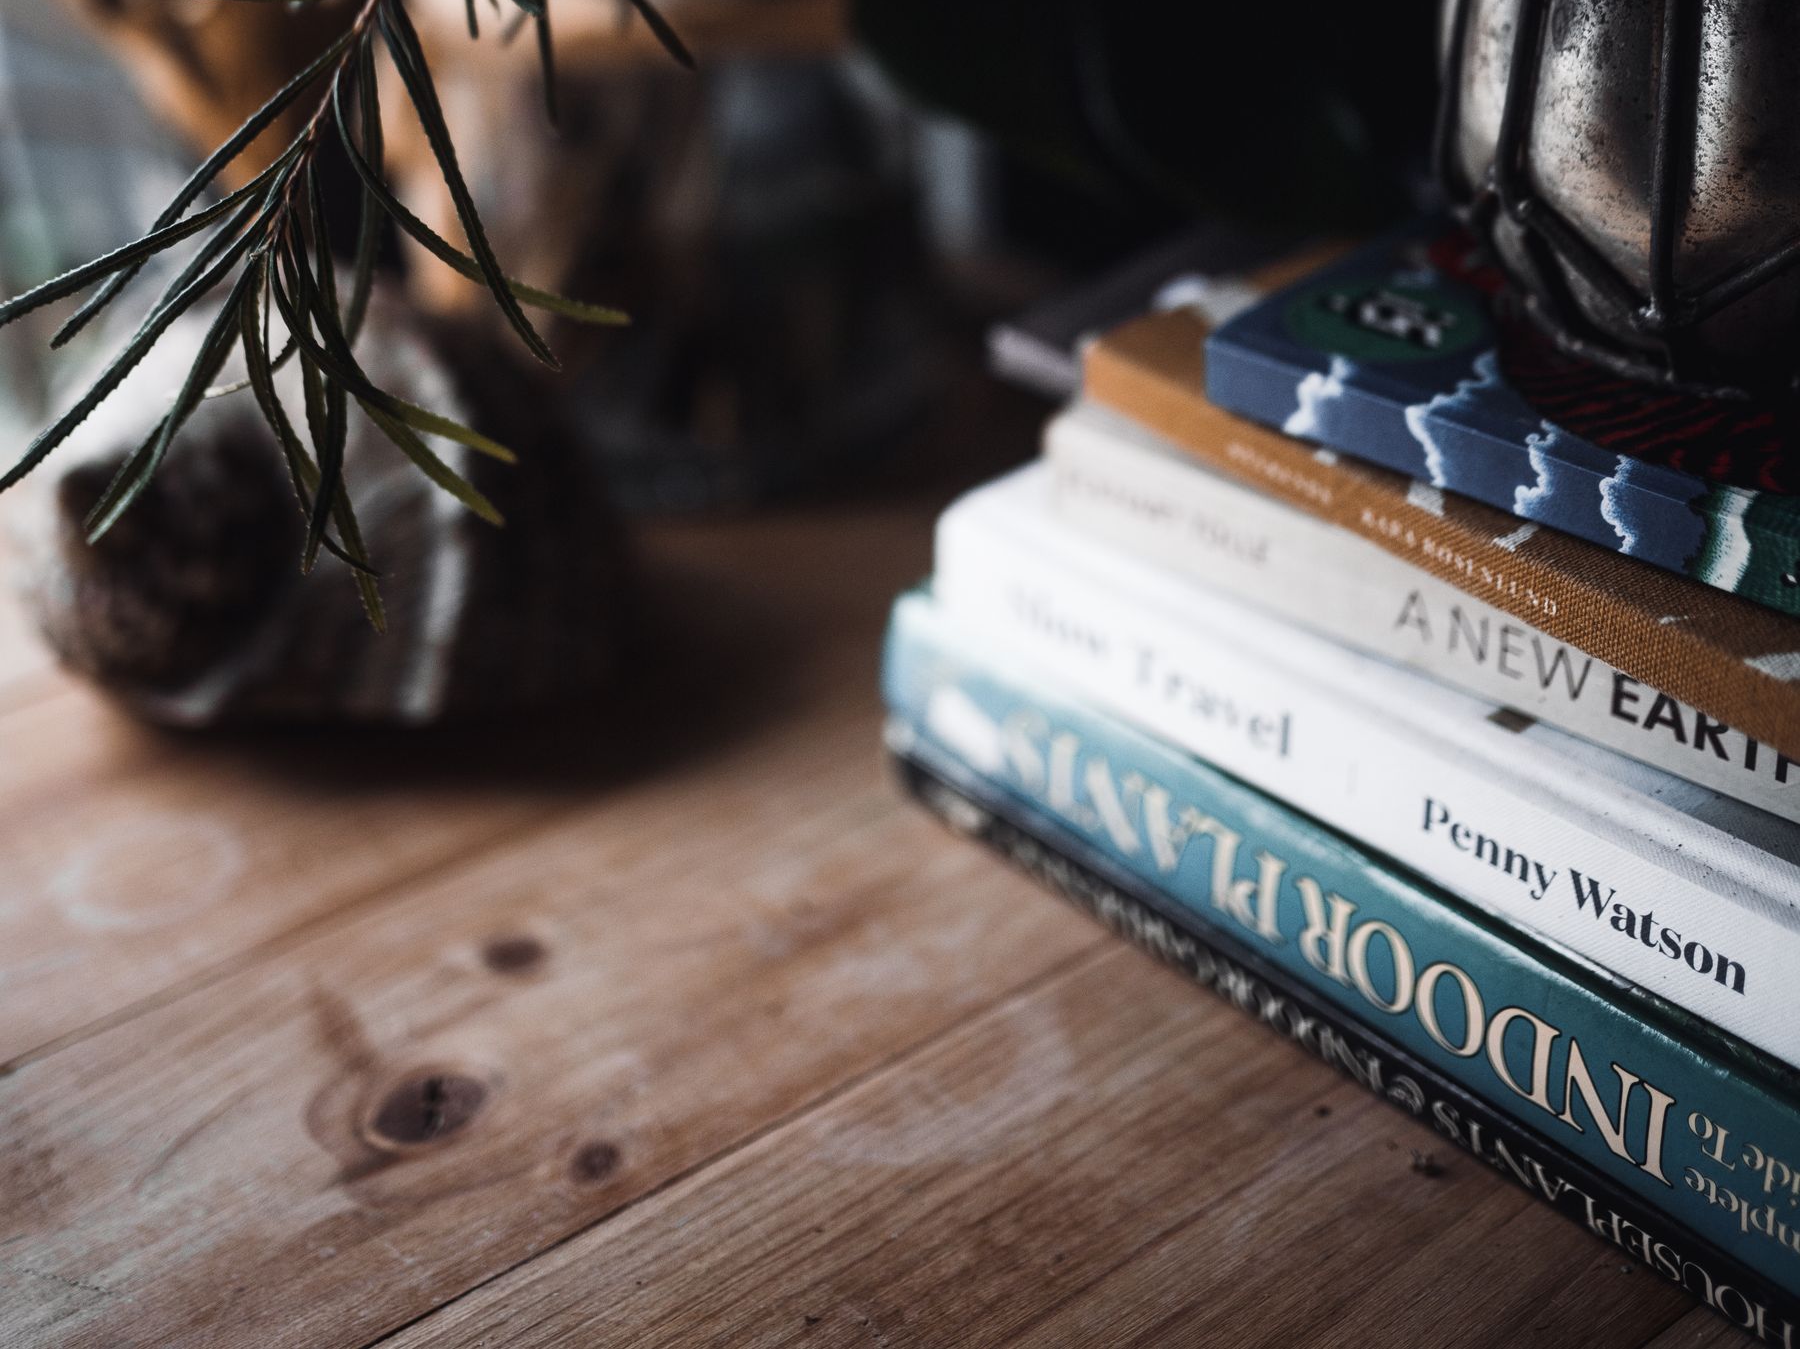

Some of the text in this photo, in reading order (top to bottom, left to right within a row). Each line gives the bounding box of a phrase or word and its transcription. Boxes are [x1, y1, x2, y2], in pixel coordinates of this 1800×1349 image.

[1394, 588, 1434, 644] A
[1447, 604, 1592, 701] NEW
[1000, 707, 1289, 946] PLANTS
[1421, 796, 1747, 997] Penny Watson
[1296, 877, 1677, 1189] INDOOR
[1687, 1111, 1737, 1171] To
[1430, 1098, 1795, 1349] HOUSEPLANTS
